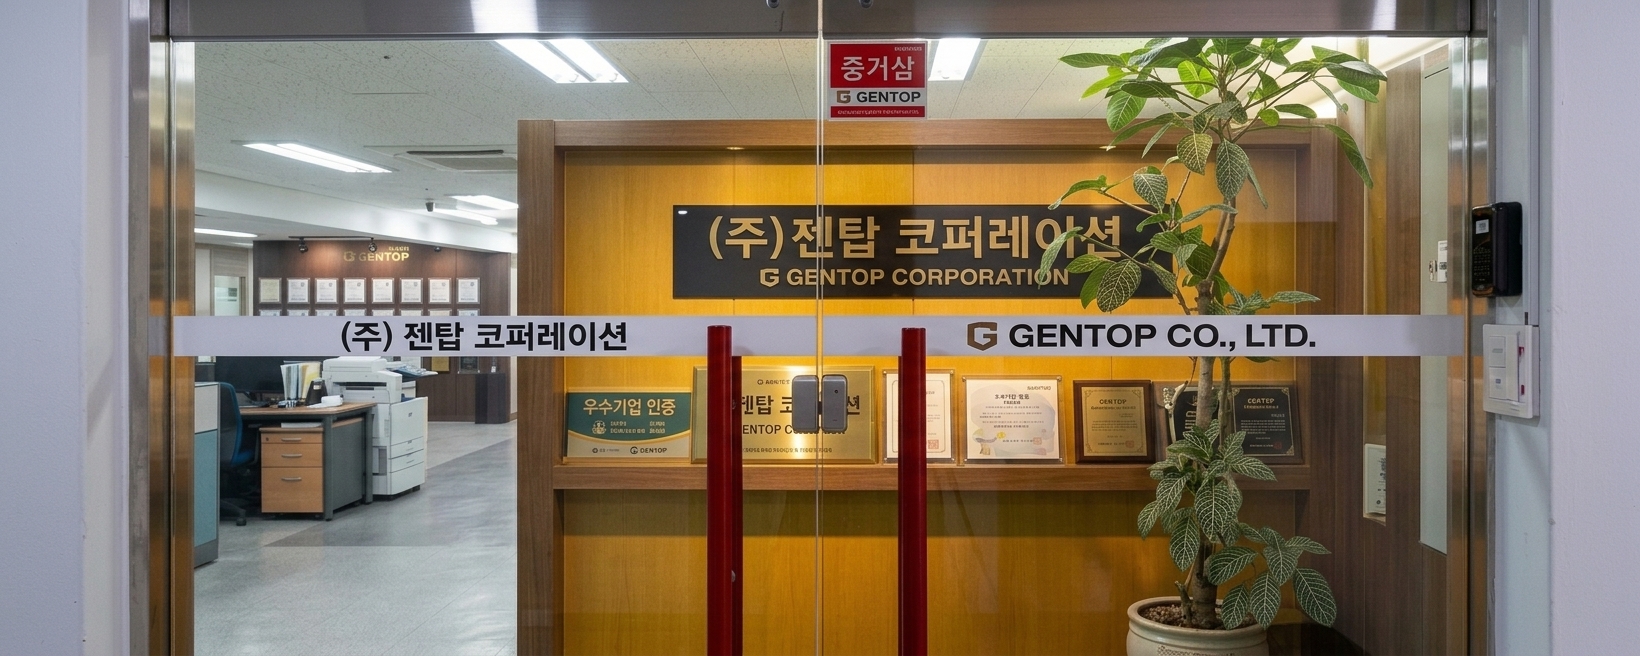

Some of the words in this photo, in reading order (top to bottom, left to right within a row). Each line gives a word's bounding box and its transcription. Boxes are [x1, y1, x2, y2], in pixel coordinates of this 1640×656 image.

[841, 56, 915, 81] 중거삼
[856, 91, 921, 103] GENTOP
[895, 215, 1122, 259] 코퍼레이션
[358, 251, 410, 262] GENTOP
[786, 268, 885, 286] GENTOP
[891, 268, 1069, 286] CORPORATION
[341, 321, 393, 352] (주)
[403, 321, 464, 351] 젠탑
[474, 321, 627, 351] 코퍼레이션
[1008, 323, 1157, 348] GENTOP
[1167, 323, 1236, 352] CO.,
[1246, 323, 1316, 348] LTD.
[583, 398, 642, 416] 우수기업
[647, 398, 676, 416] 인증
[743, 424, 781, 435] ENTOP
